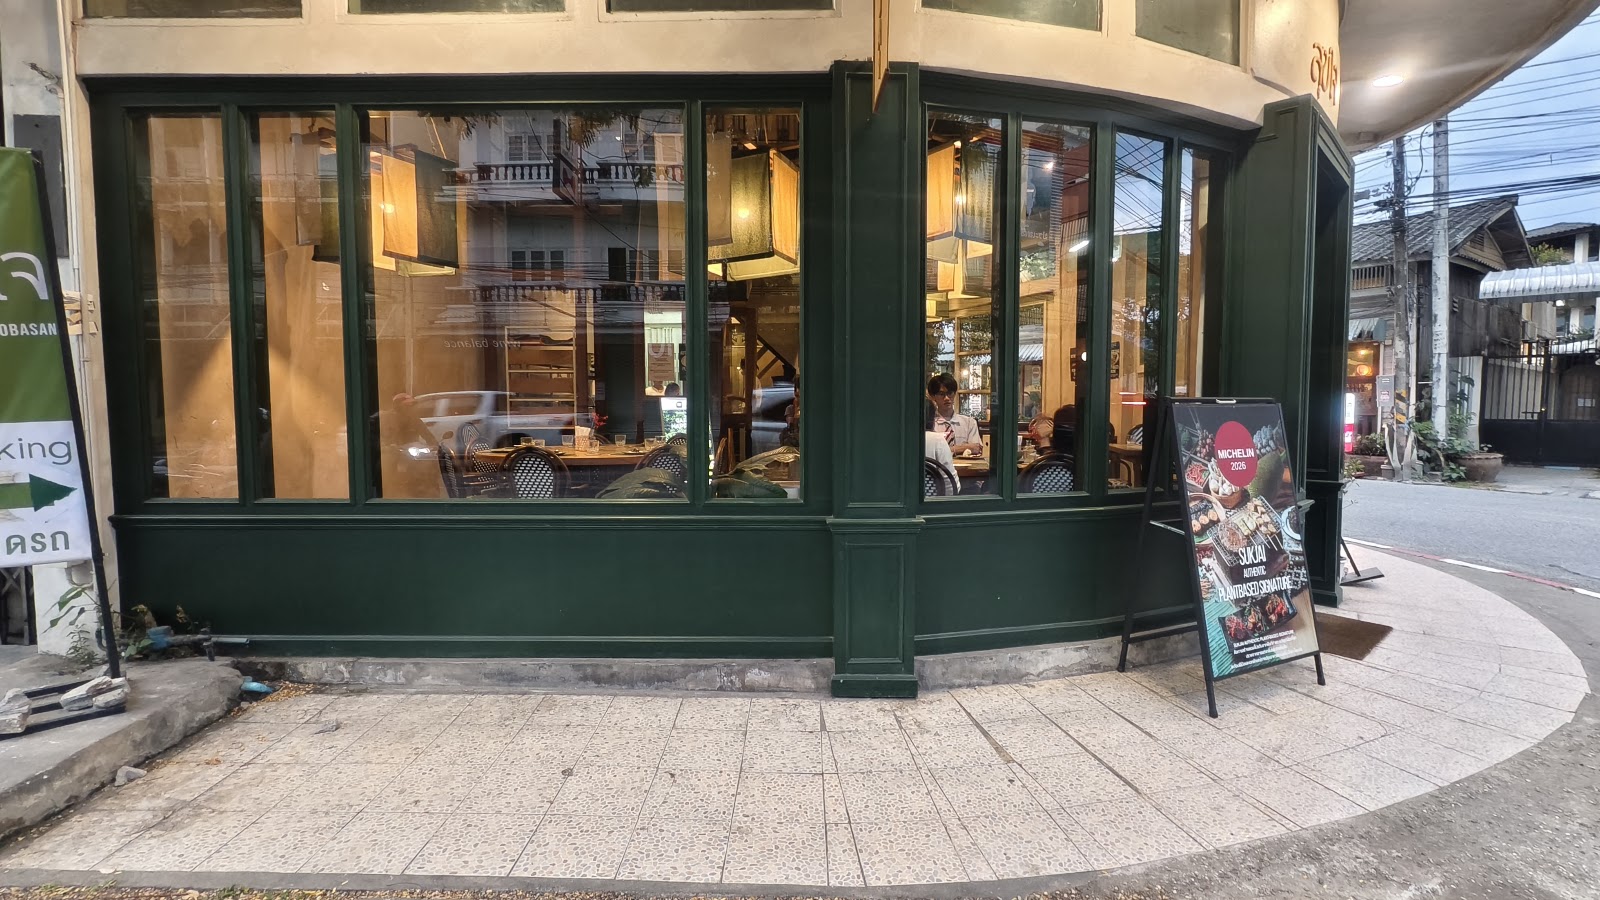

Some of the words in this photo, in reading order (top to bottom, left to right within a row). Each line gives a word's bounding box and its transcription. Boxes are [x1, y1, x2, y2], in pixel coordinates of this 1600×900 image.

[1217, 447, 1255, 459] MICHELIN
[1230, 461, 1247, 471] 2026
[1238, 544, 1267, 566] SUKJAI
[1243, 565, 1267, 579] AUTHENTIC
[1218, 580, 1260, 602] PLANTBASED
[1259, 575, 1294, 595] SIGNATURE
